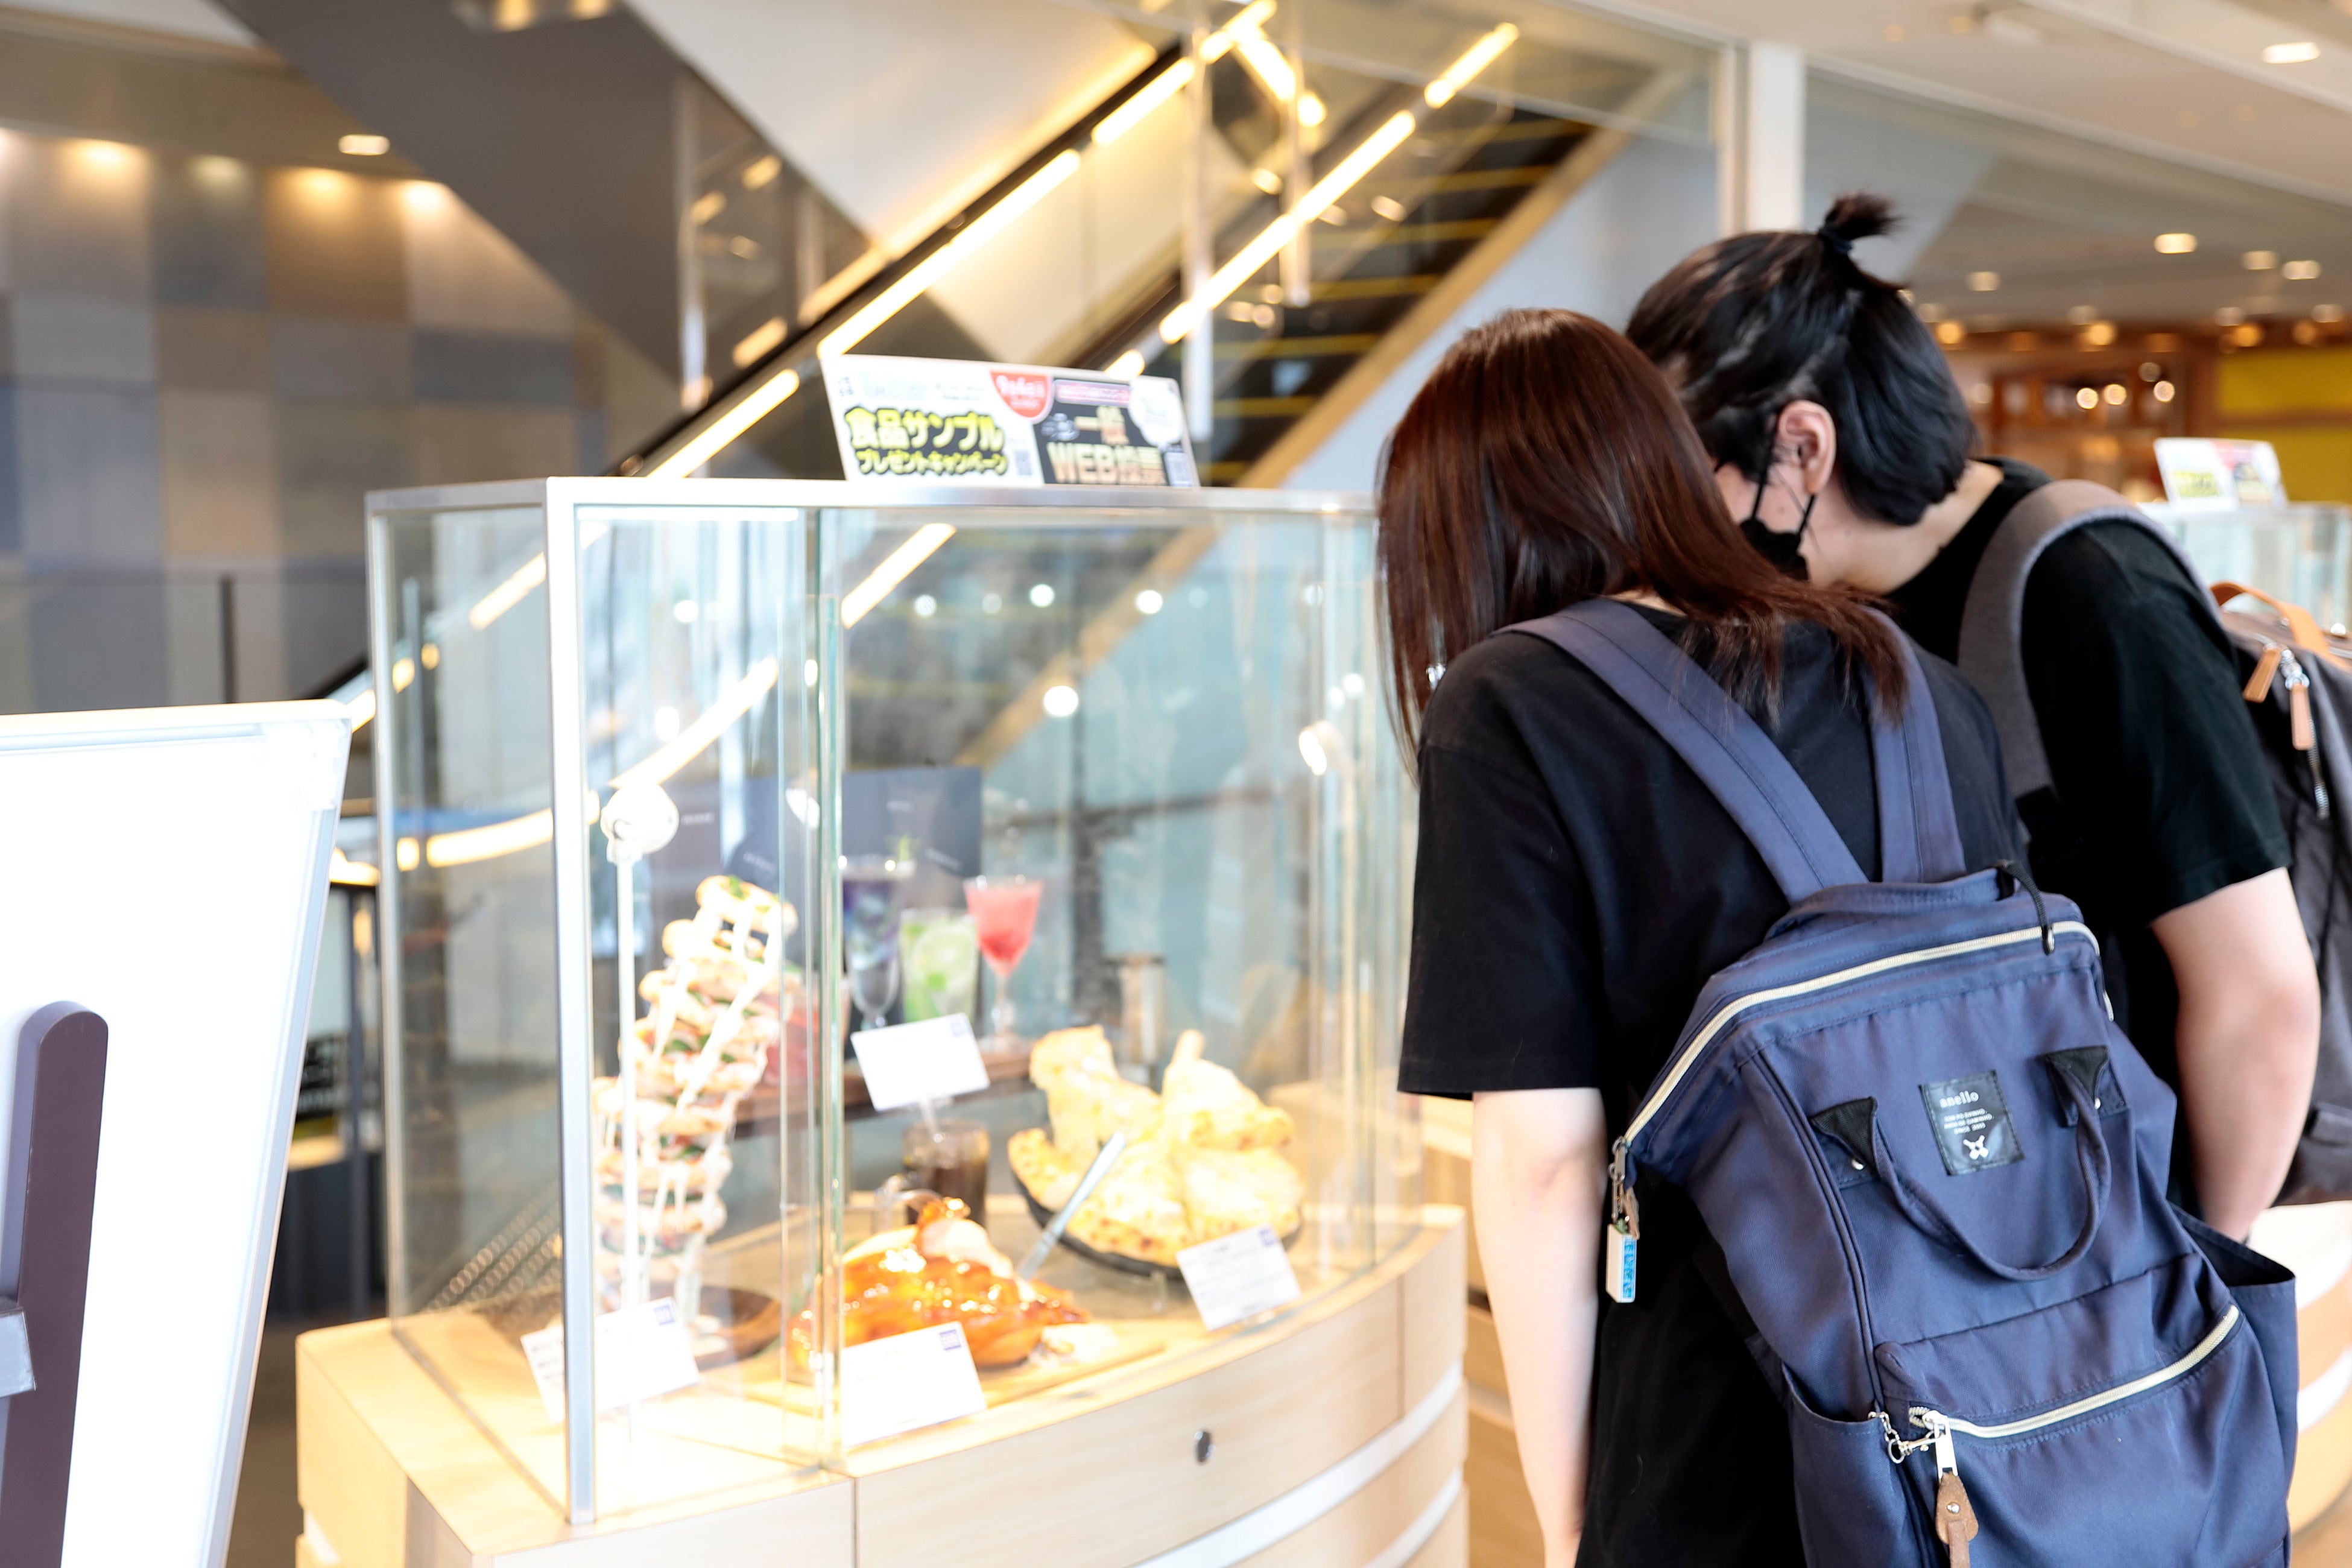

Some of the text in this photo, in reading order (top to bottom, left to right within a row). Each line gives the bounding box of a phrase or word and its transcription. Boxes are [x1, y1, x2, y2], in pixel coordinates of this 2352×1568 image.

[845, 406, 1004, 450] 食品サンプル
[856, 449, 1008, 475] プレゼントキャンペーン
[1939, 1090, 1979, 1108] anello
